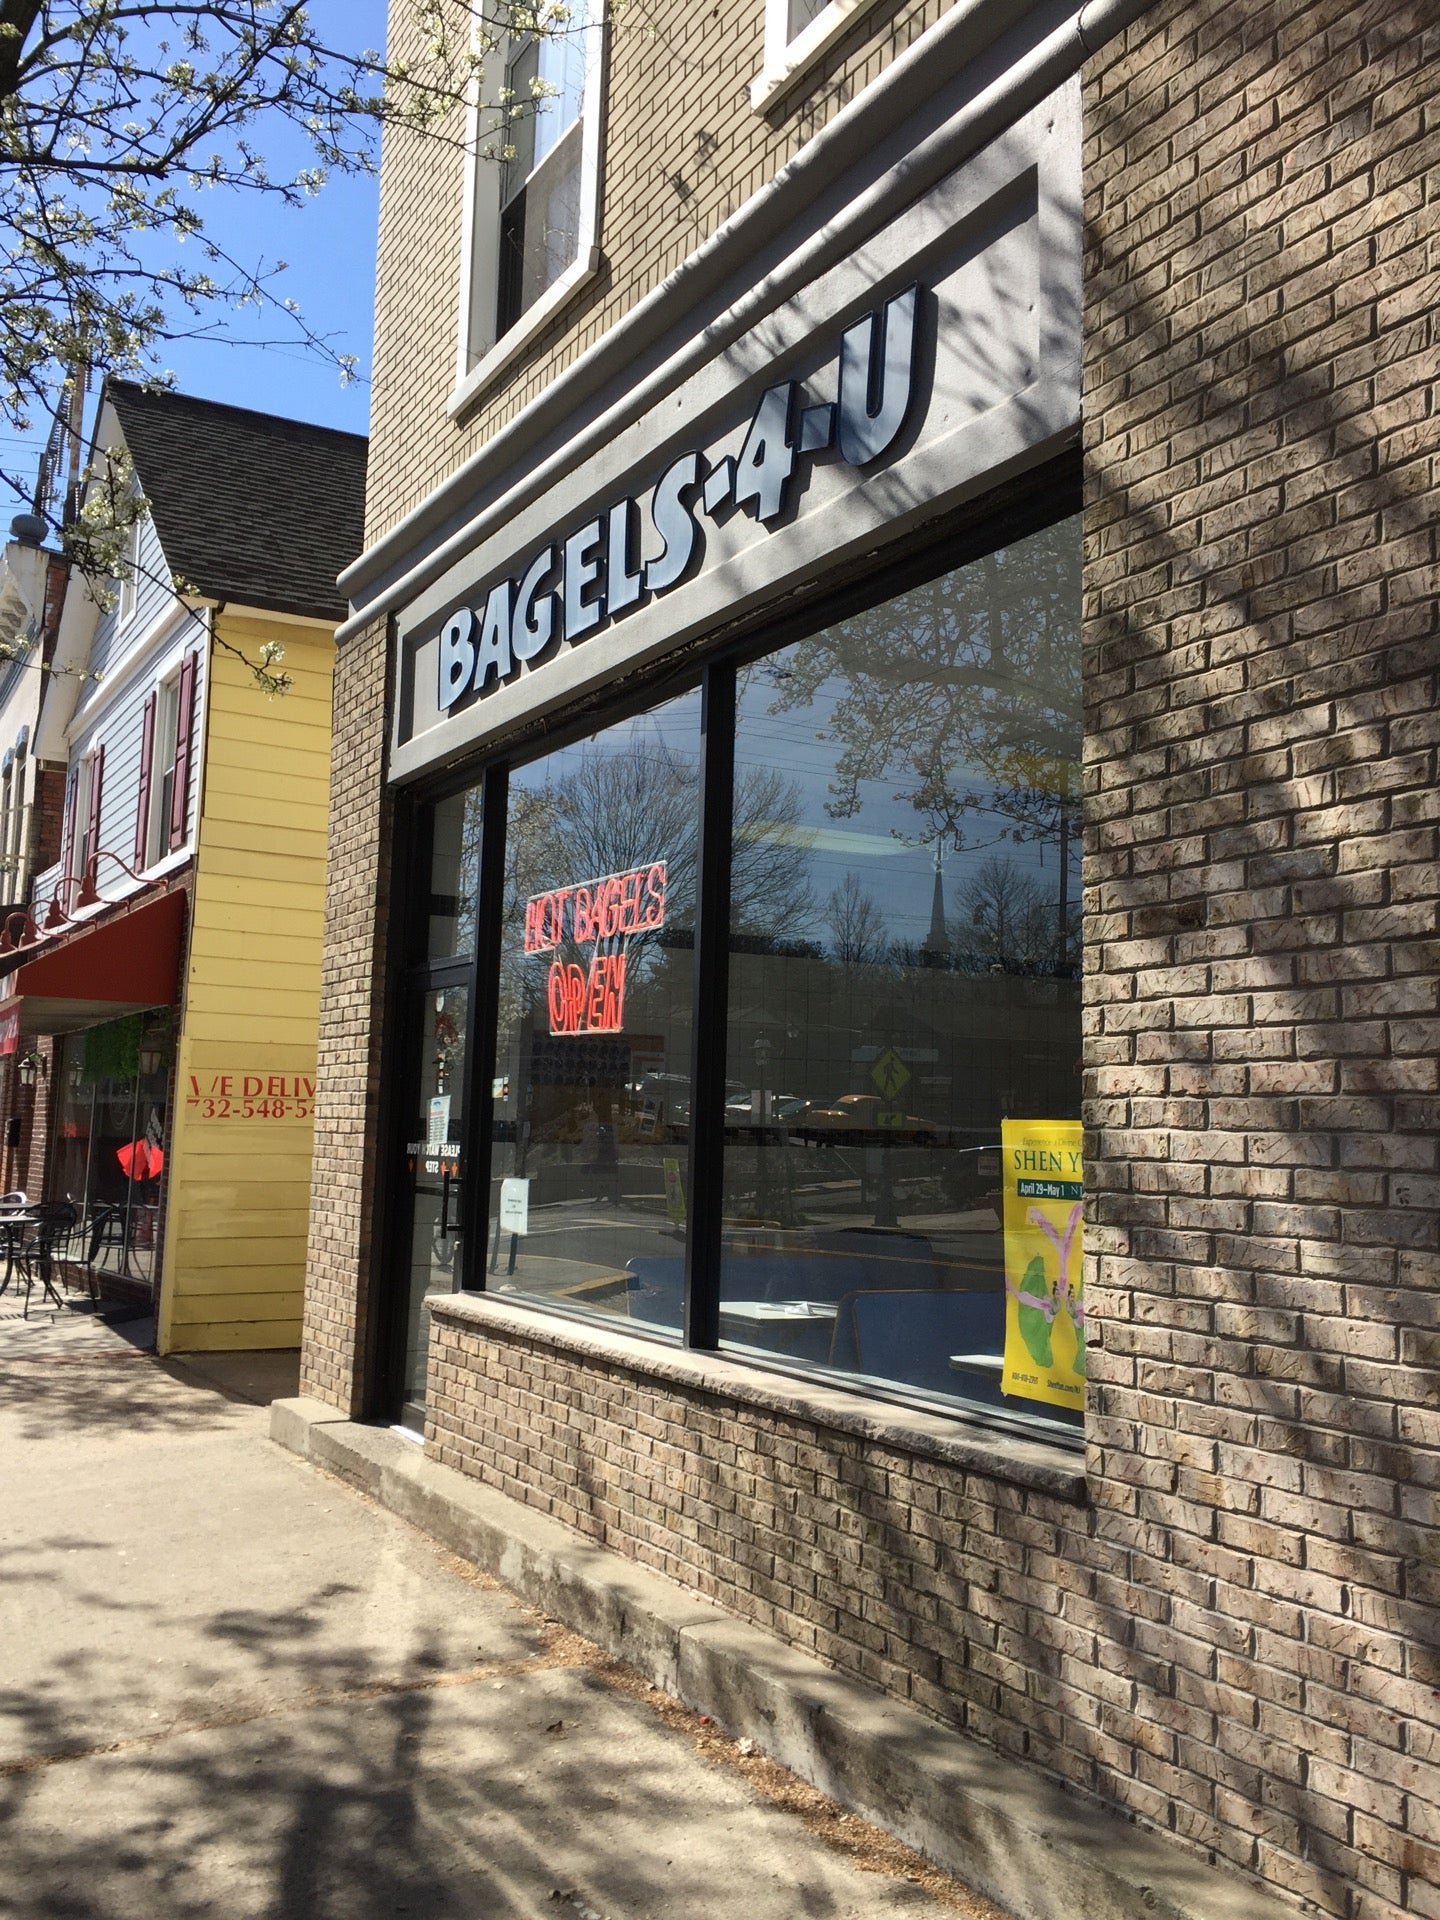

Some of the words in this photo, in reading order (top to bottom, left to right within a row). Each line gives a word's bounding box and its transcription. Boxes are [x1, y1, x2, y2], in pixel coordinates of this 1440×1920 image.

[438, 280, 922, 711] BAGELS-4-U
[525, 890, 572, 951] HOT
[574, 865, 667, 943] BAGELS
[547, 953, 625, 1034] OPEN
[1014, 1150, 1062, 1171] SHEN
[1020, 1182, 1034, 1195] April
